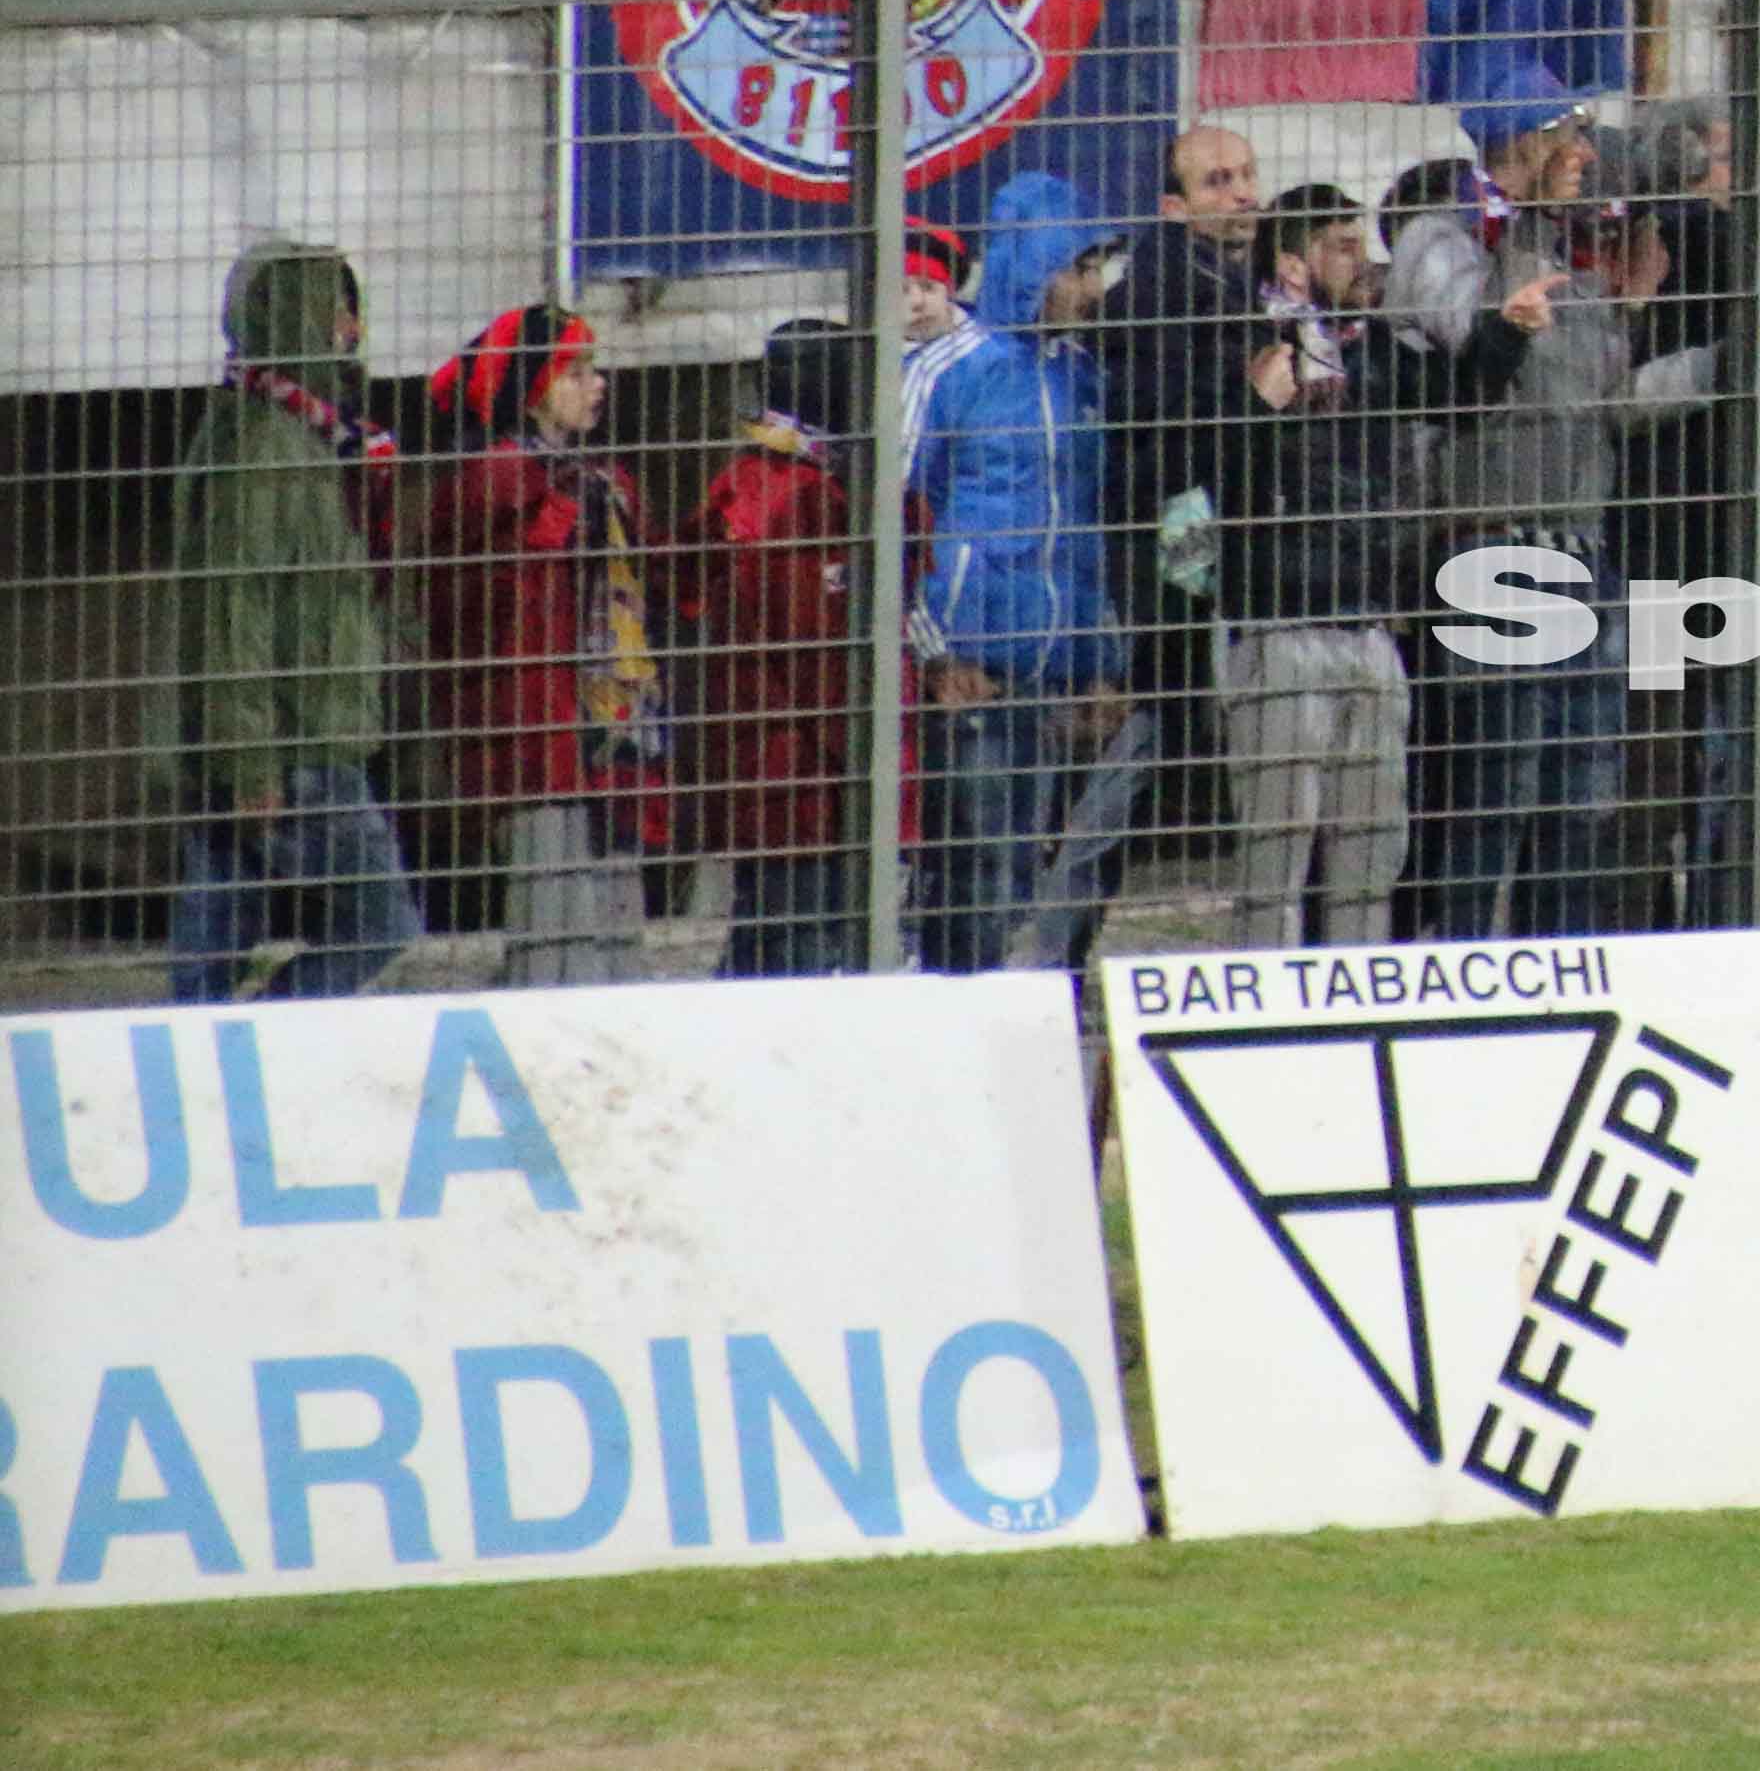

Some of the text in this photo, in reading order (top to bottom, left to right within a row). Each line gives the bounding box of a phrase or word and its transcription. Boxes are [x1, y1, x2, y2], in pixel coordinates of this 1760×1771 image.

[1130, 946, 1613, 1017] BAR TABACCHI
[12, 1008, 583, 1241] ULA
[1461, 1024, 1735, 1518] EFFEPI
[0, 1318, 1102, 1590] ARDINO
